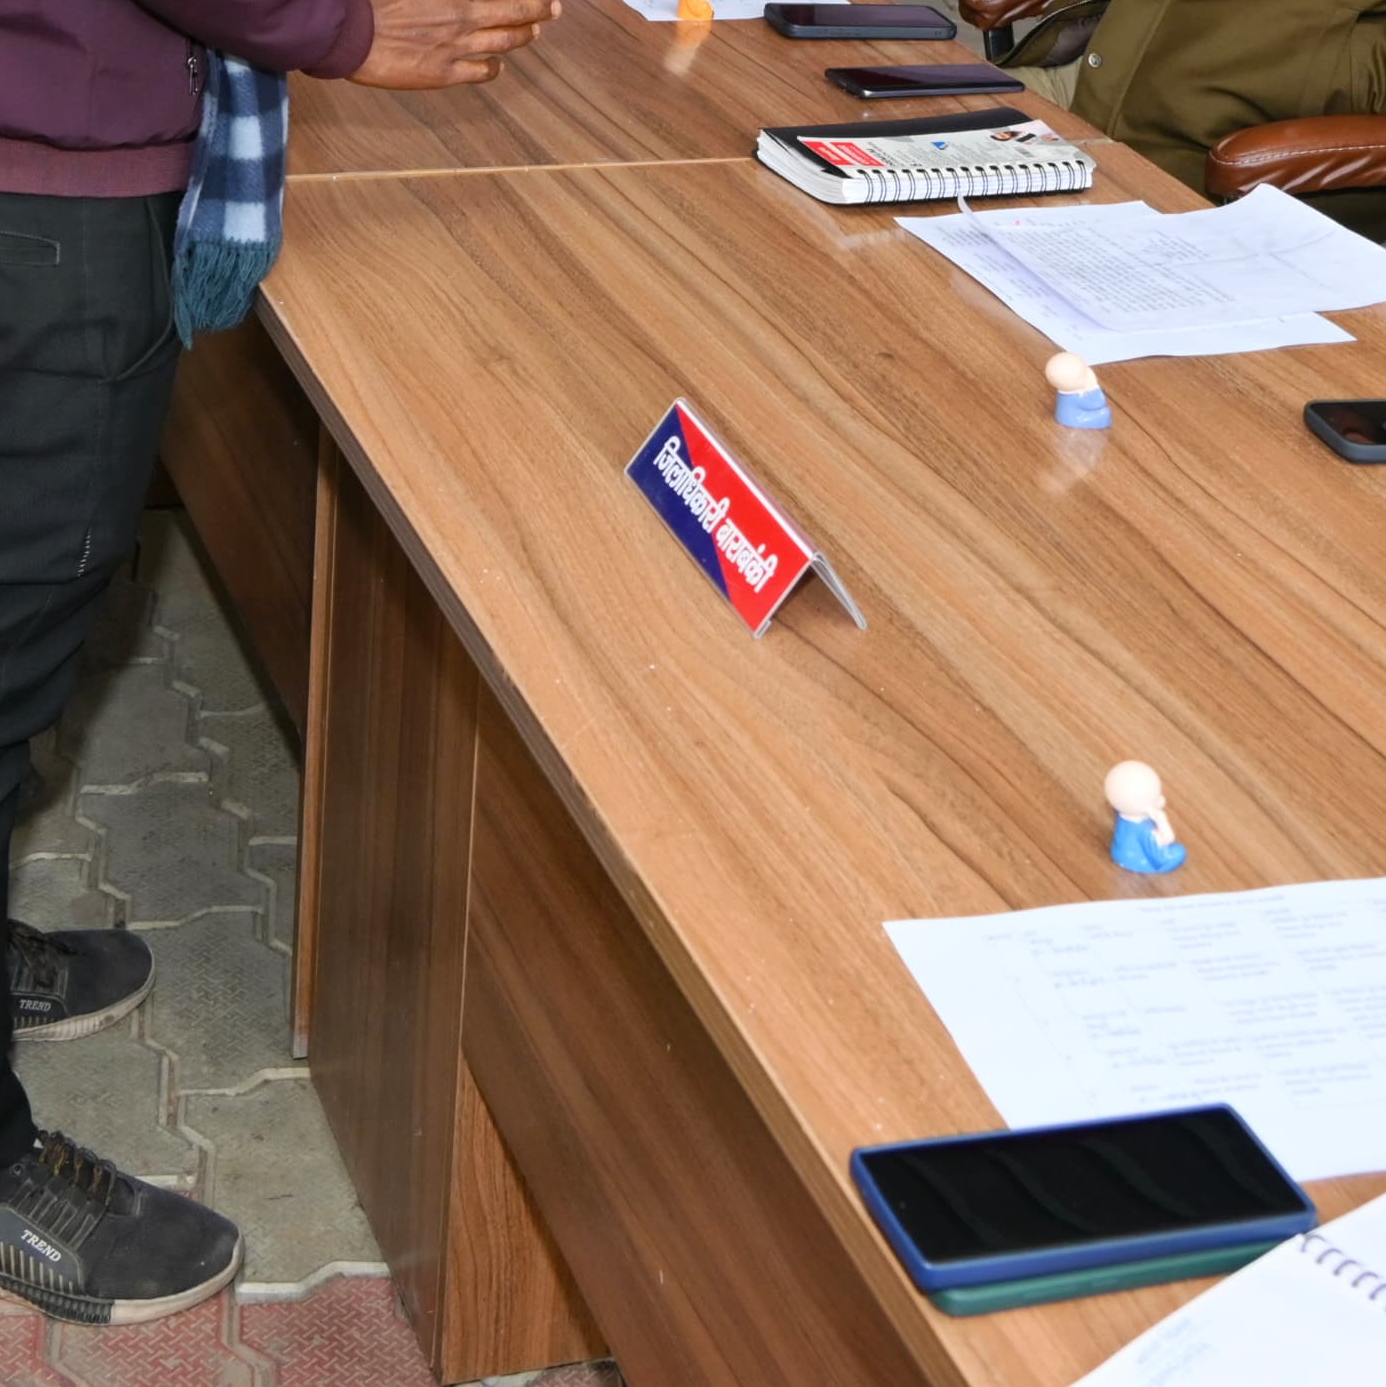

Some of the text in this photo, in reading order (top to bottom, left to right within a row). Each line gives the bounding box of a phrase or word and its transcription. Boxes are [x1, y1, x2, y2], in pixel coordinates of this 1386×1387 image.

[653, 435, 730, 534] जिलाधिकारी
[19, 998, 52, 1013] TREND
[21, 1230, 62, 1262] TREND
